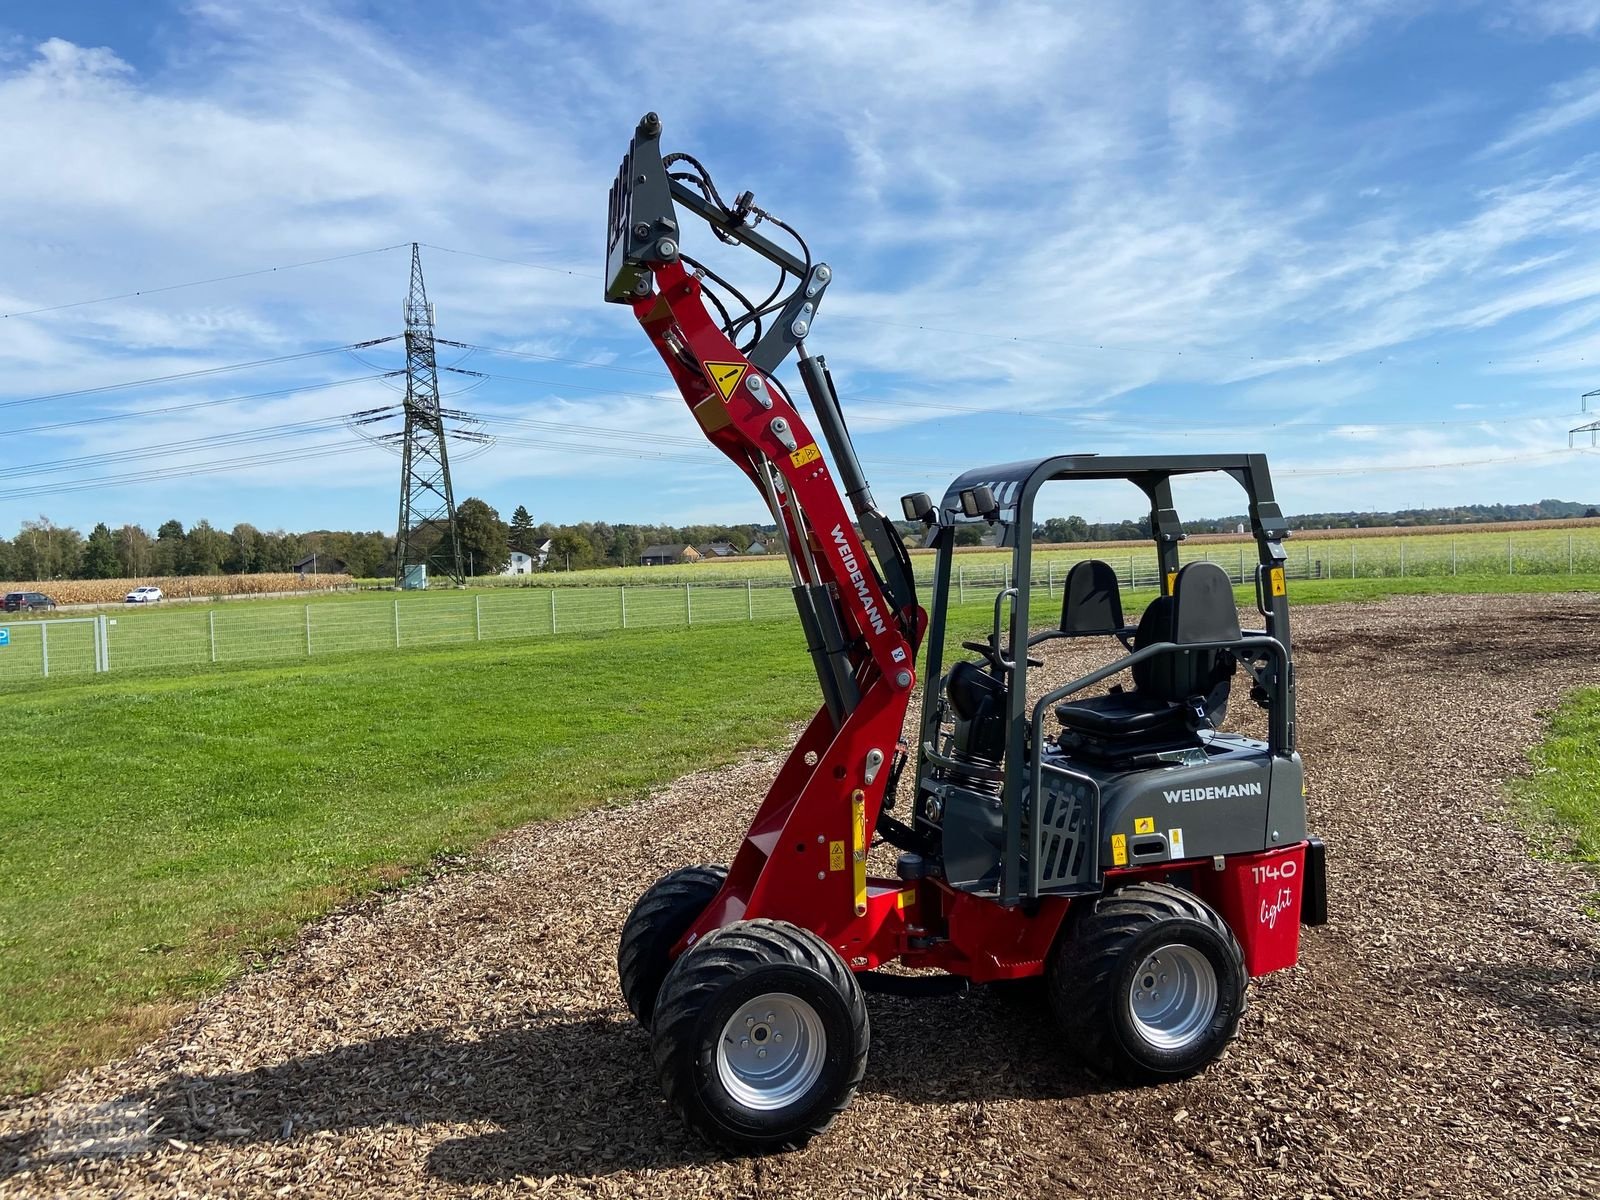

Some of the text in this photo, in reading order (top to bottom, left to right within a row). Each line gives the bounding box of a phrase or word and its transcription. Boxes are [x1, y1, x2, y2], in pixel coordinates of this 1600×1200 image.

[831, 524, 886, 635] WEIDEMANN
[1163, 783, 1261, 803] WEIDEMANN
[1252, 861, 1296, 885] 1140
[1260, 887, 1292, 929] light
